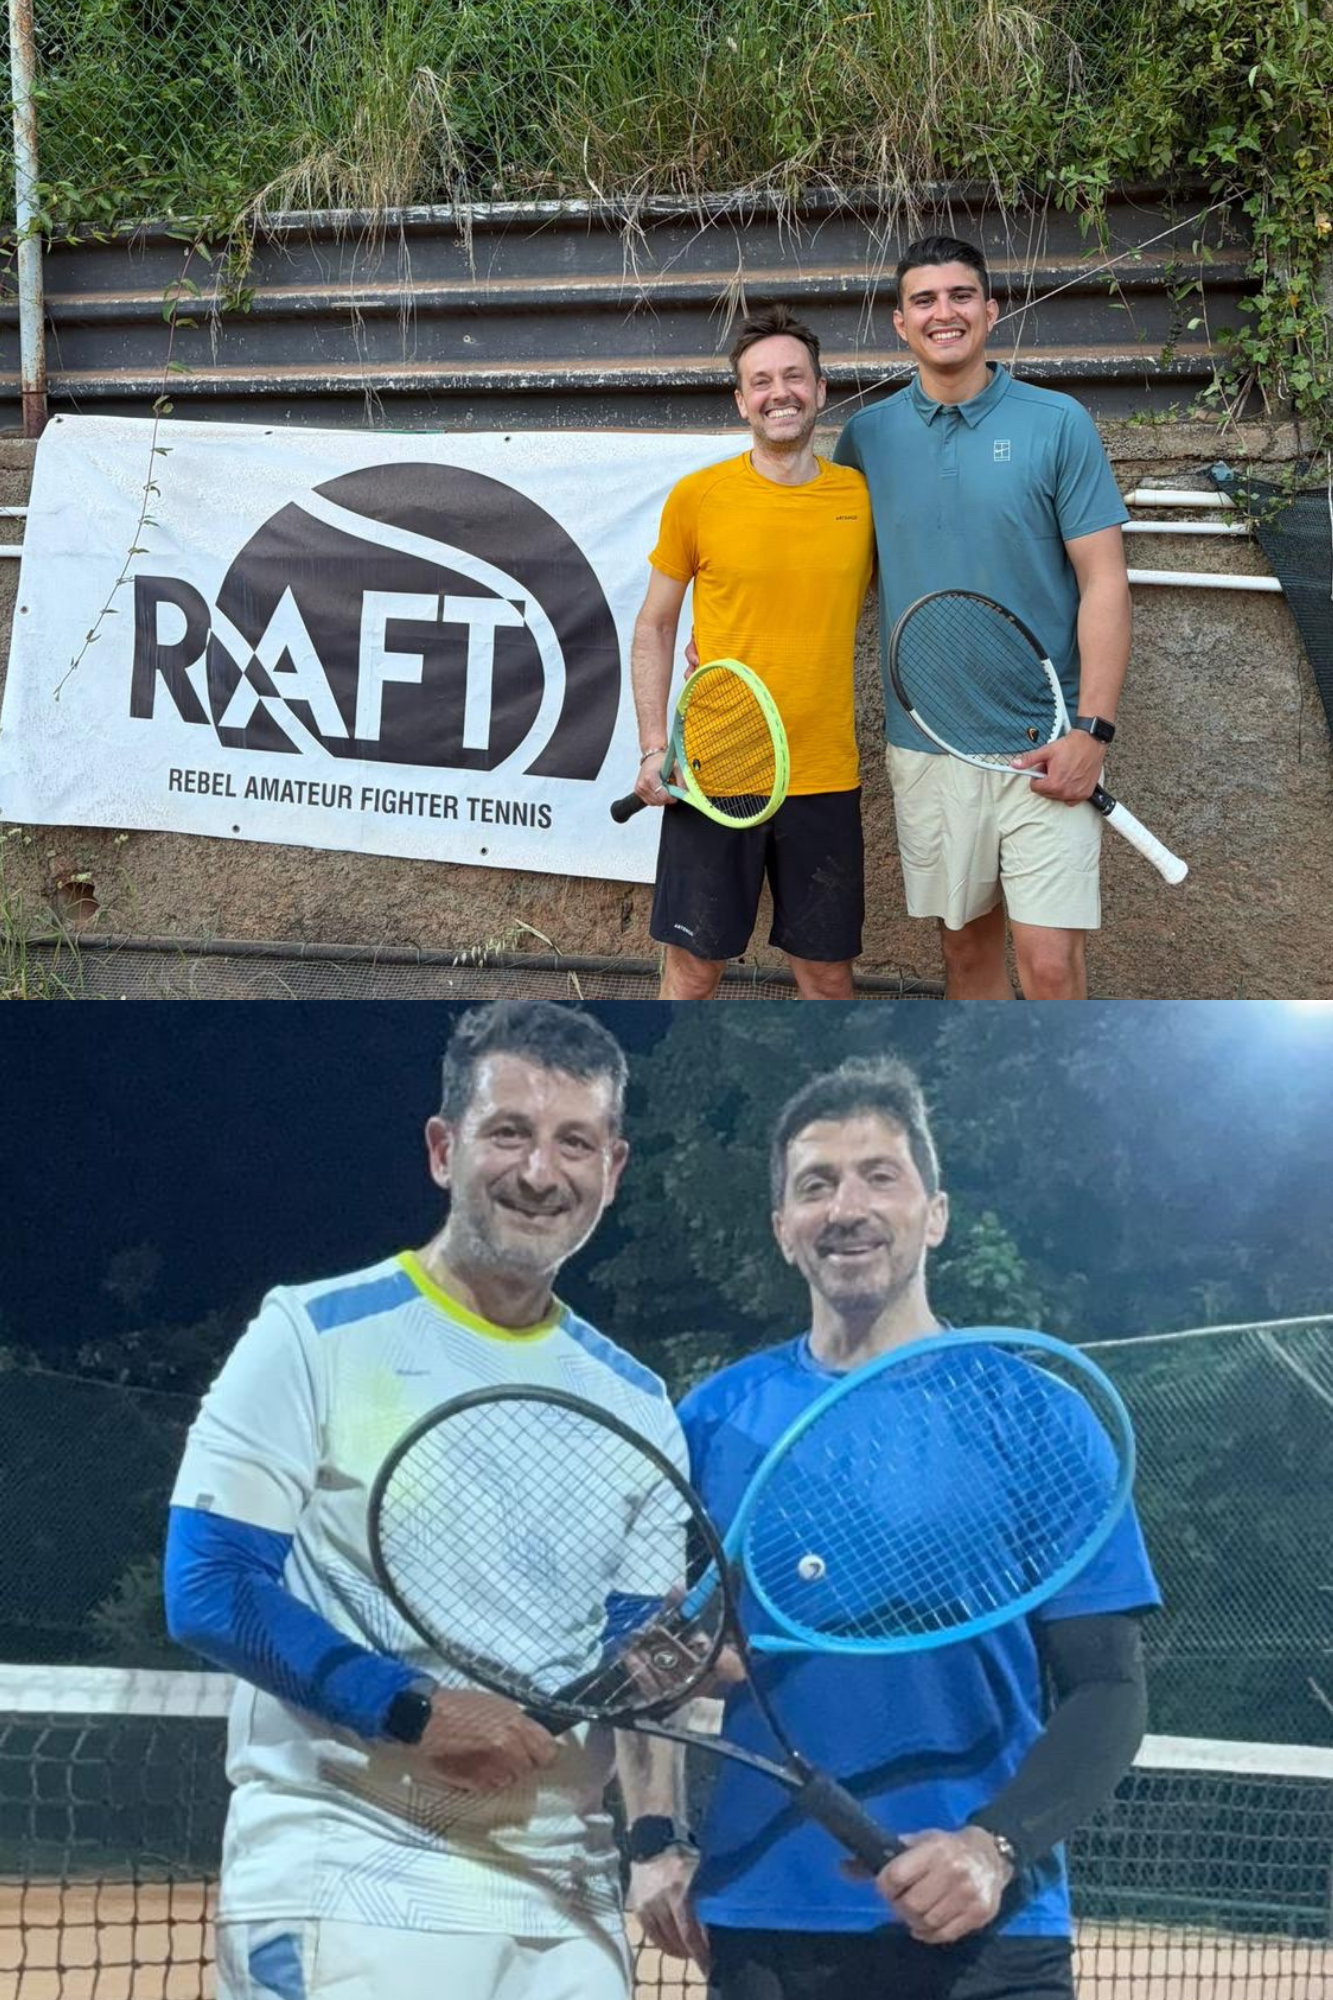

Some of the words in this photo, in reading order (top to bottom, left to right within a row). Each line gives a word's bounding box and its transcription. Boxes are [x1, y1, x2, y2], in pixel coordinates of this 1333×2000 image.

[130, 574, 526, 751] RAFT
[169, 768, 237, 798] REBEL
[244, 776, 353, 809] AMATEUR
[360, 787, 458, 820] FIGHTER
[467, 797, 552, 829] TENNIS
